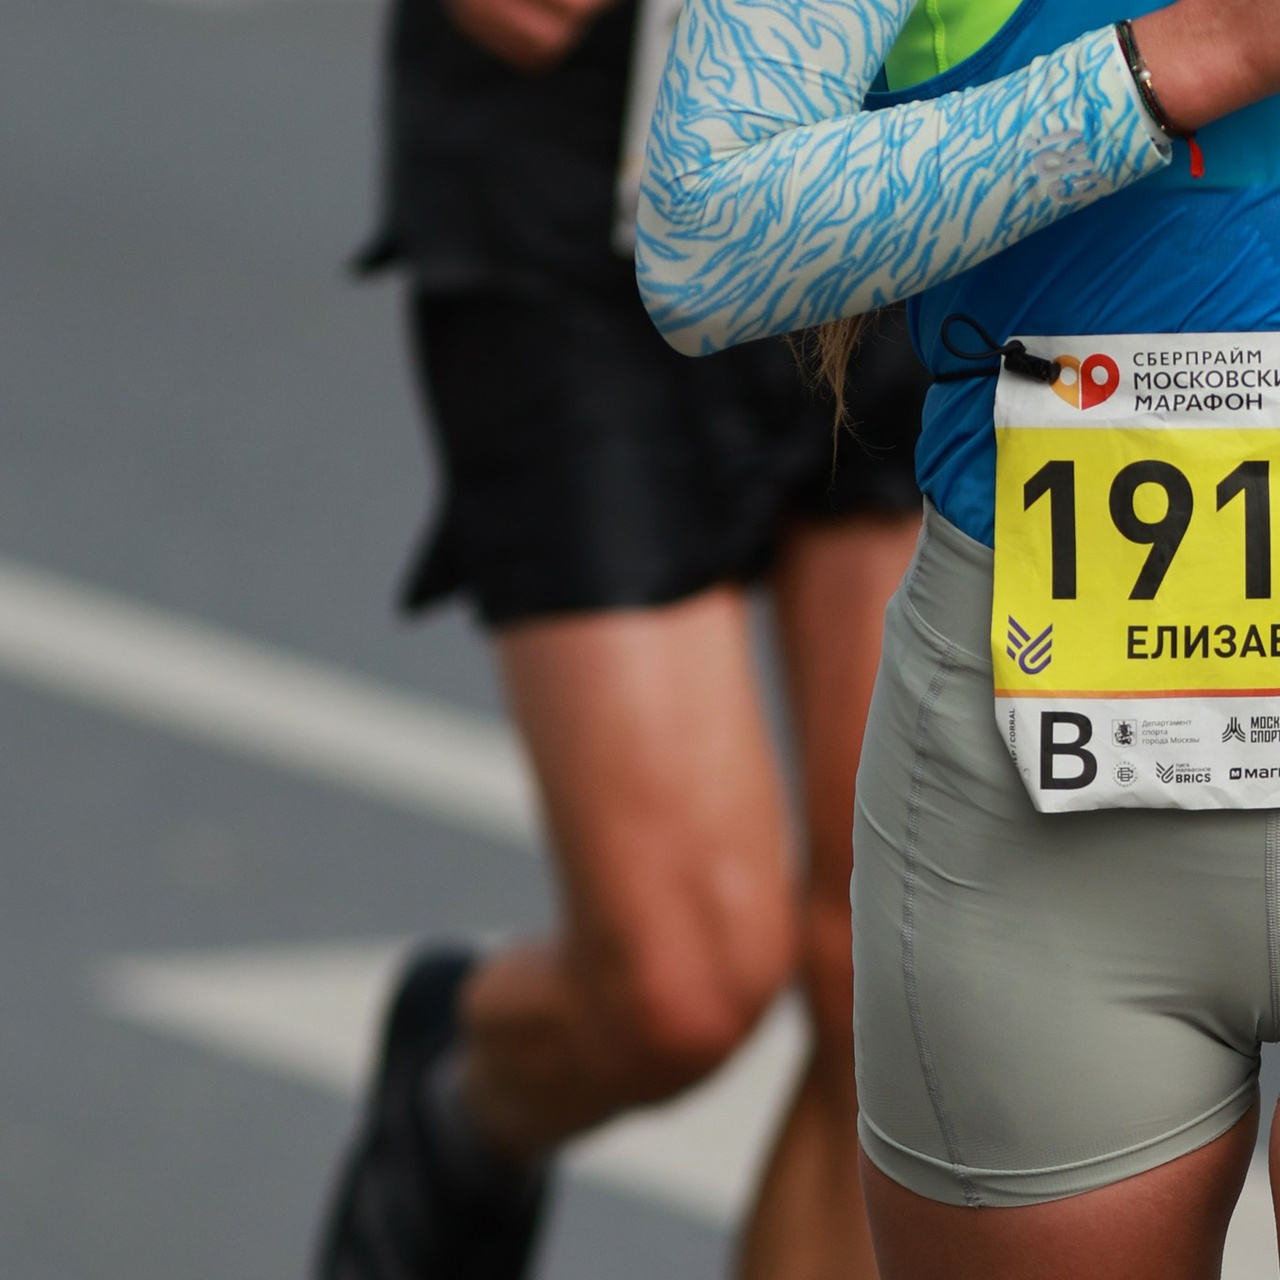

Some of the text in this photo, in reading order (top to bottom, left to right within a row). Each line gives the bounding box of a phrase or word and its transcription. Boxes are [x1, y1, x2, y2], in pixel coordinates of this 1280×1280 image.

[1133, 347, 1262, 366] СБЕРПРАЙМ
[1134, 393, 1263, 412] МАРАФОН
[1141, 720, 1192, 728] Департамент
[1176, 773, 1211, 784] BRICS
